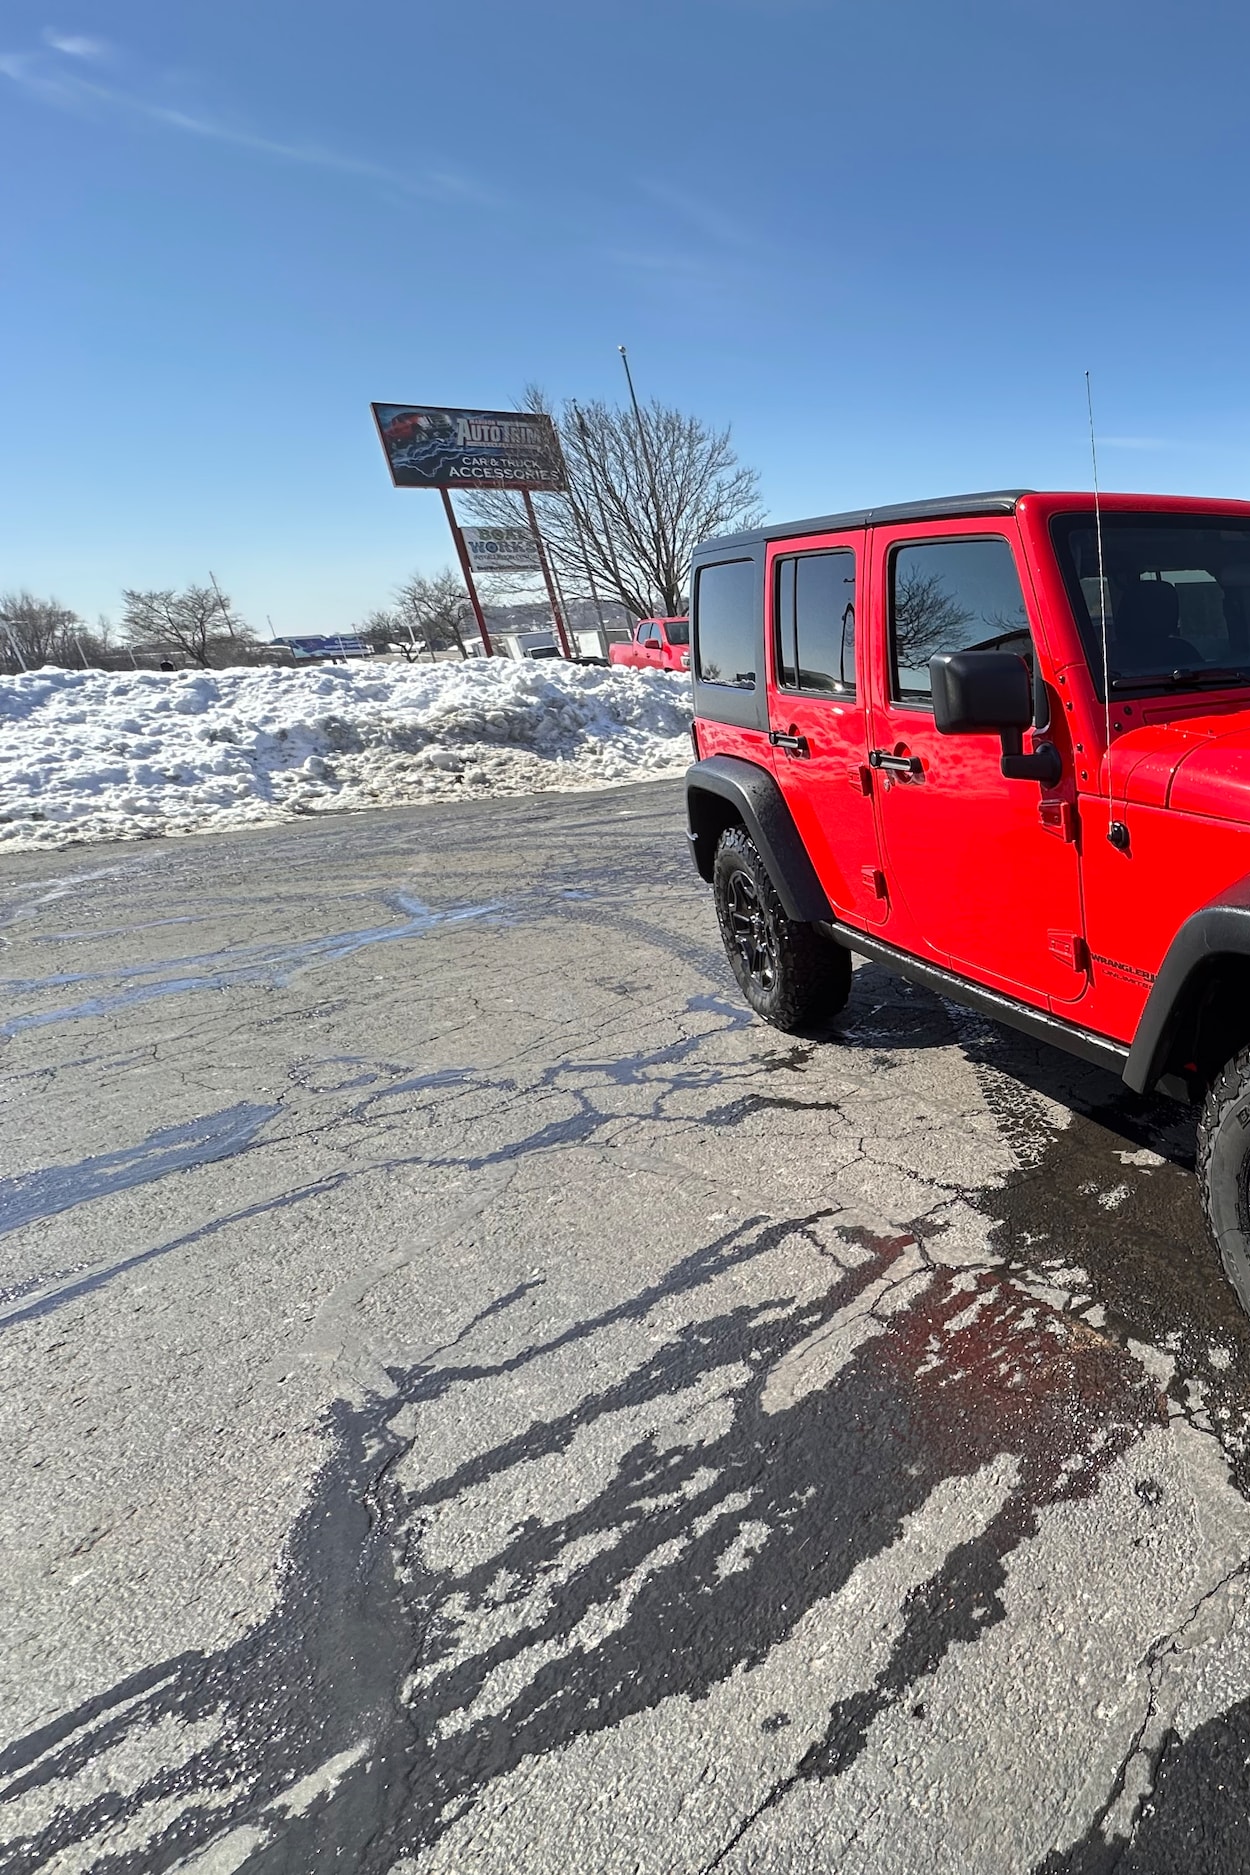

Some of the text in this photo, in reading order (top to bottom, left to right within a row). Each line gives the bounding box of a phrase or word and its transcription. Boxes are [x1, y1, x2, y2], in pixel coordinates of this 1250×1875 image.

[462, 457, 541, 469] CAR & TRUCK
[449, 466, 560, 480] ACCESSORIES
[467, 541, 537, 554] WORKS
